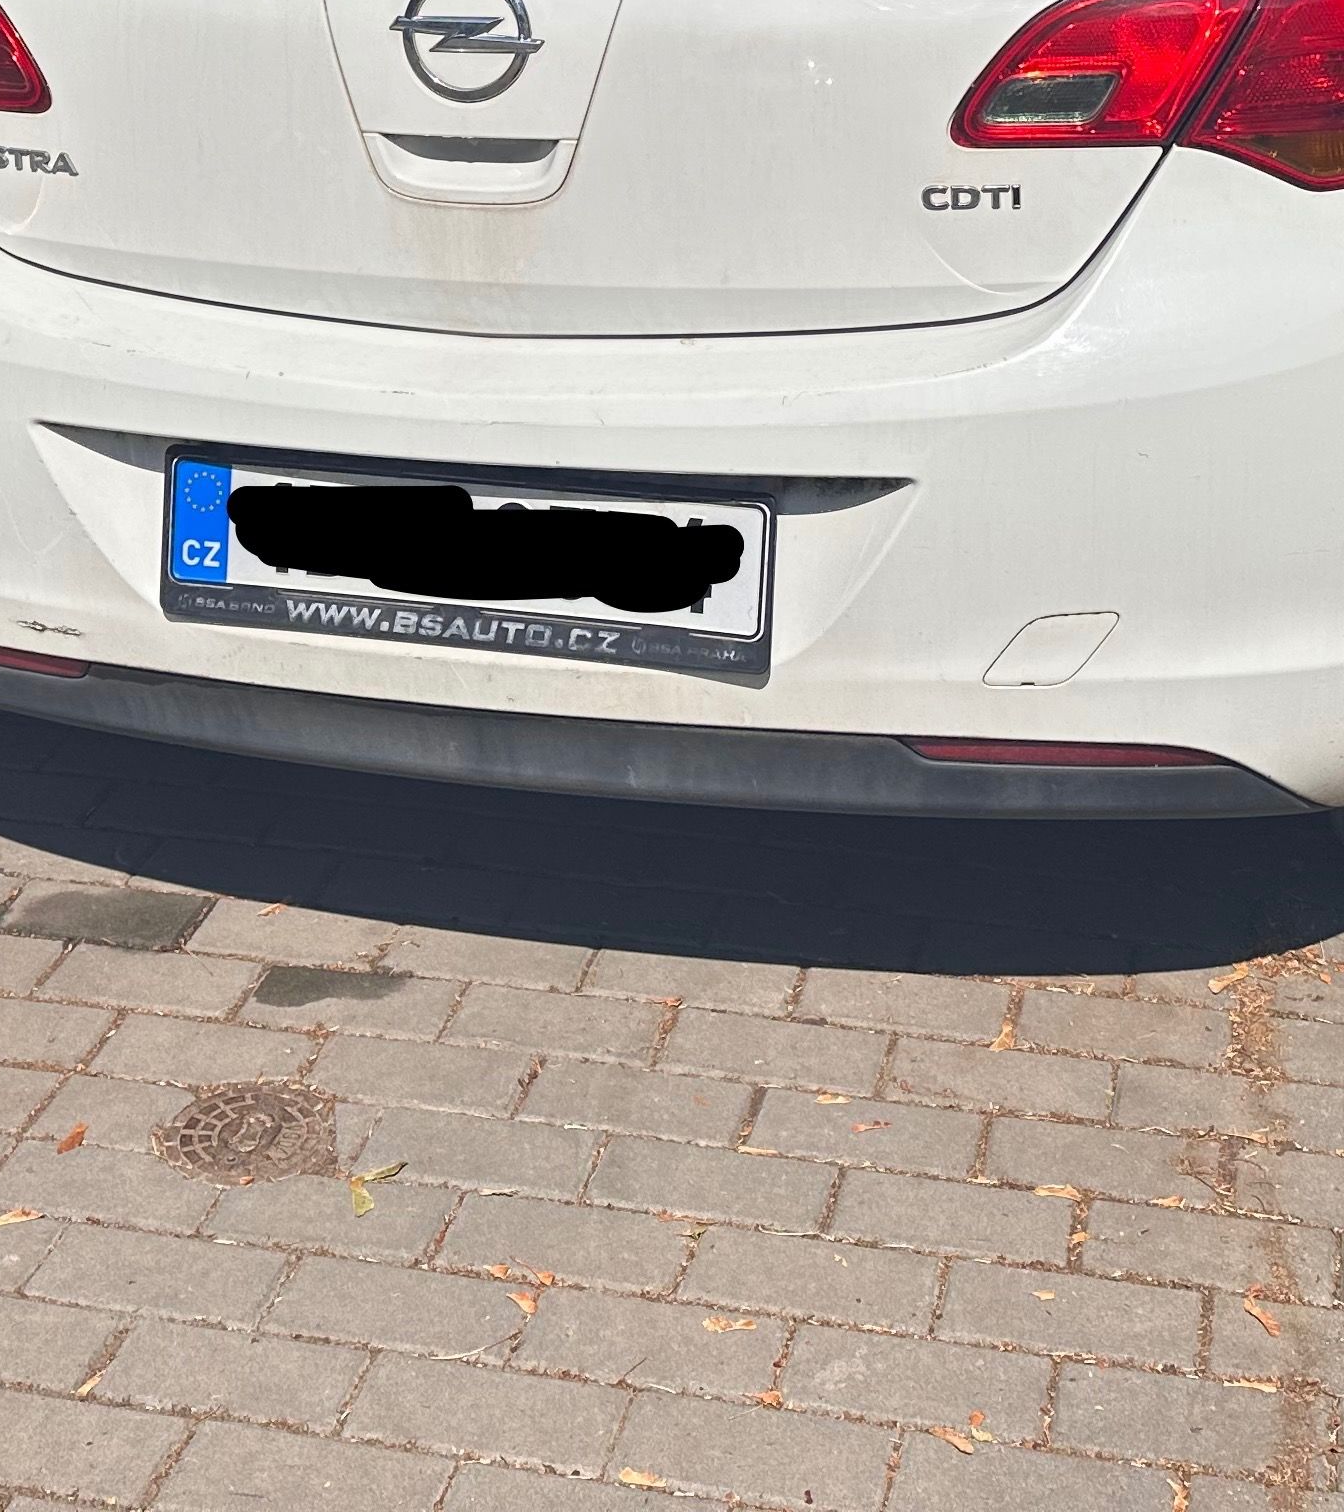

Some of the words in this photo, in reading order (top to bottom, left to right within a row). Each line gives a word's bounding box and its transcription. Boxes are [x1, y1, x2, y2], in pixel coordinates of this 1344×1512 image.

[920, 184, 1022, 211] CDTI
[182, 538, 222, 568] CZ
[195, 596, 226, 609] BSA
[286, 599, 621, 655] WWW.BSAUTO.CZ
